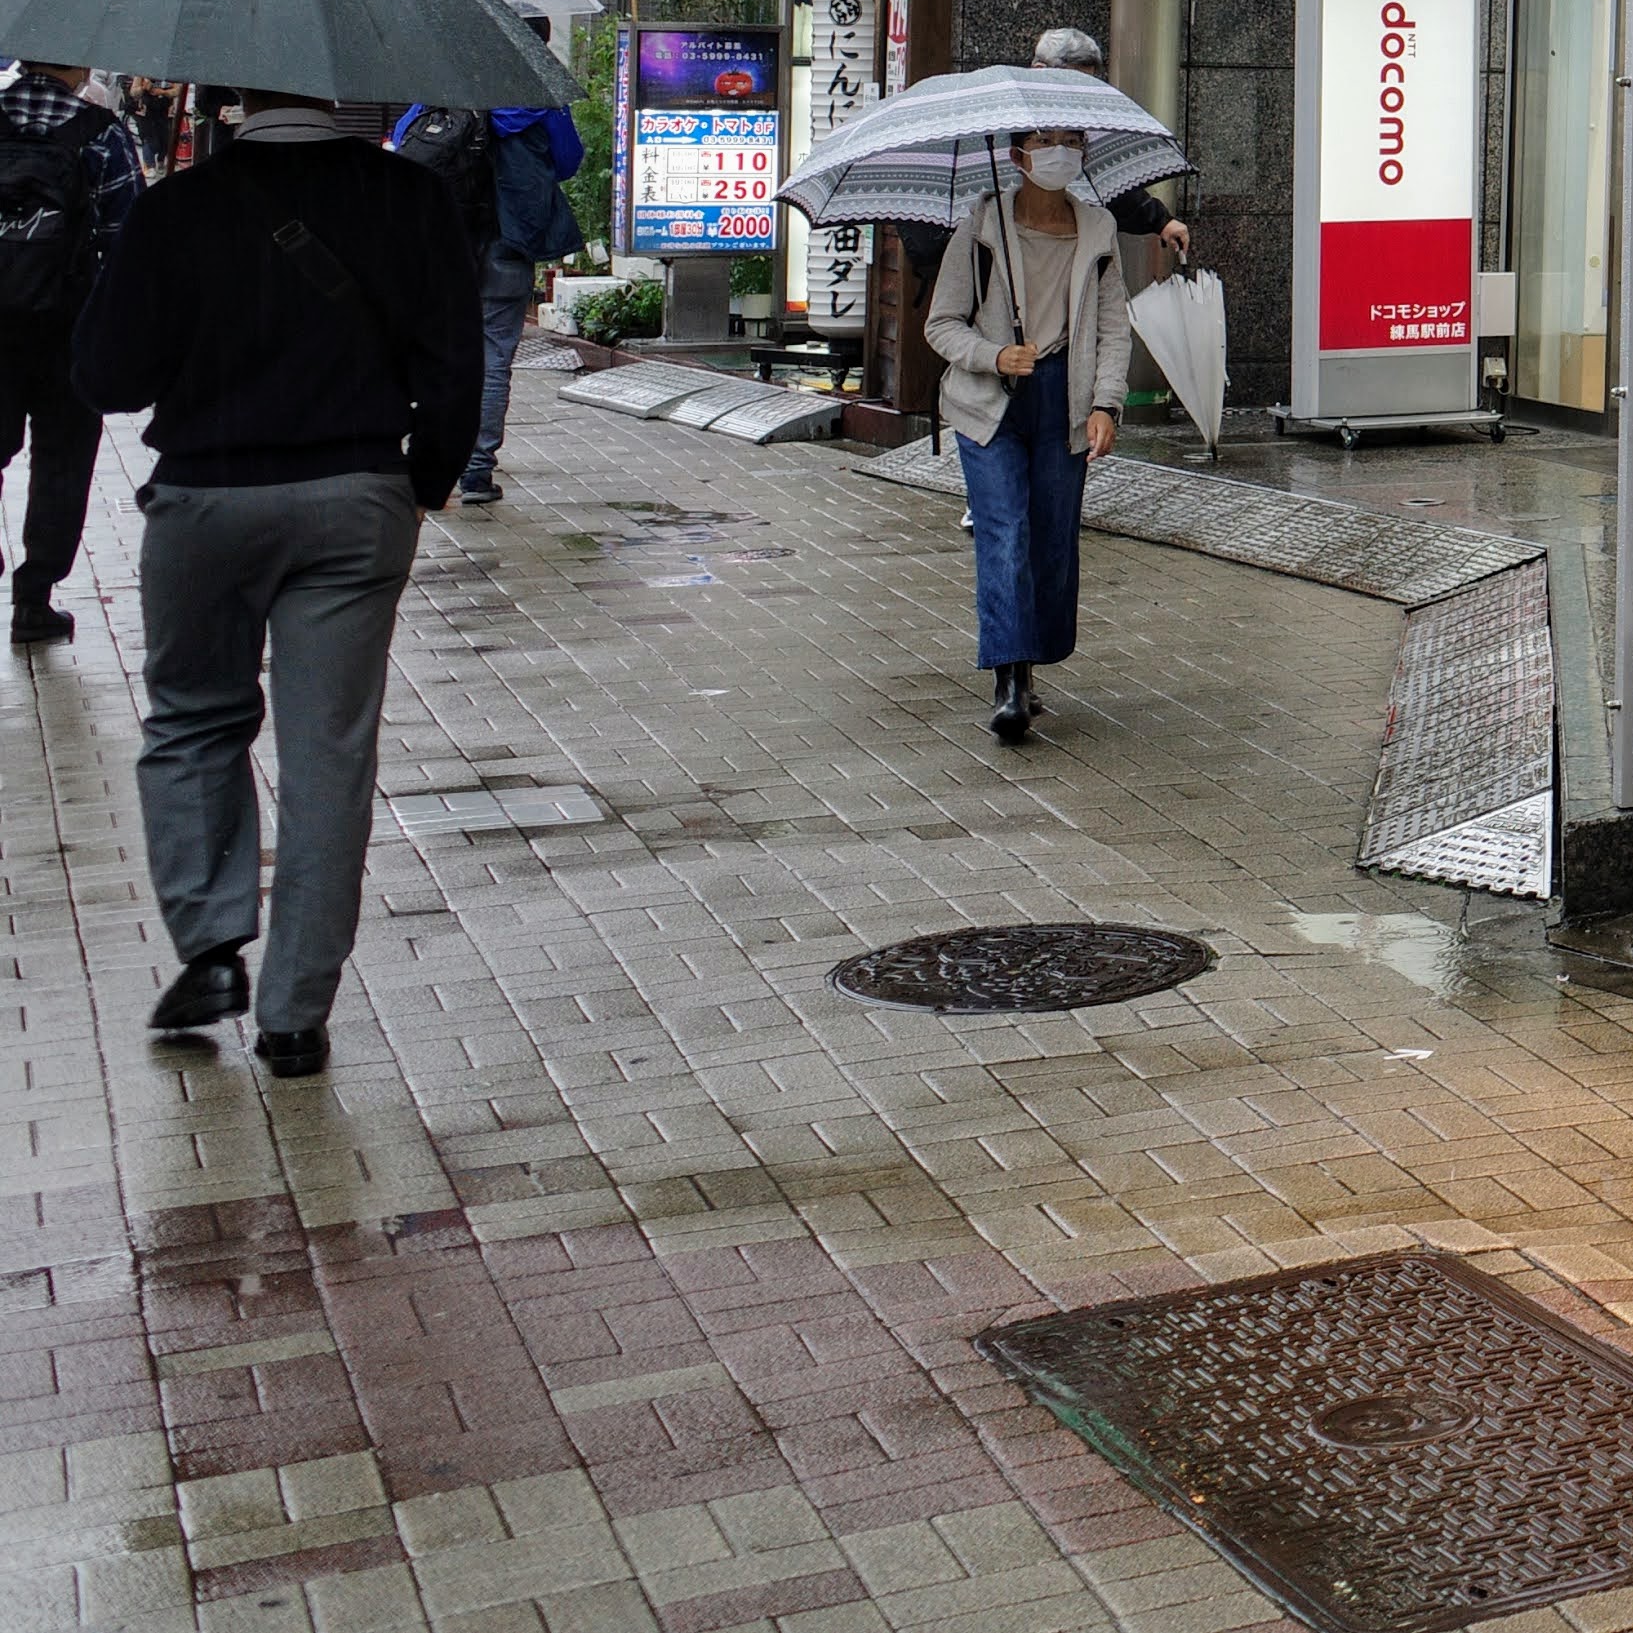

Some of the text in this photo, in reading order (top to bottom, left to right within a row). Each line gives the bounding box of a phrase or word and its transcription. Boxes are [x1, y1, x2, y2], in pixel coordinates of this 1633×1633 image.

[1407, 32, 1417, 59] NTT
[1379, 1, 1417, 186] docomo
[641, 115, 753, 135] カラオケ・トマト
[1369, 301, 1466, 322] ドコモショップ
[1389, 322, 1466, 341] 練馬駅前店
